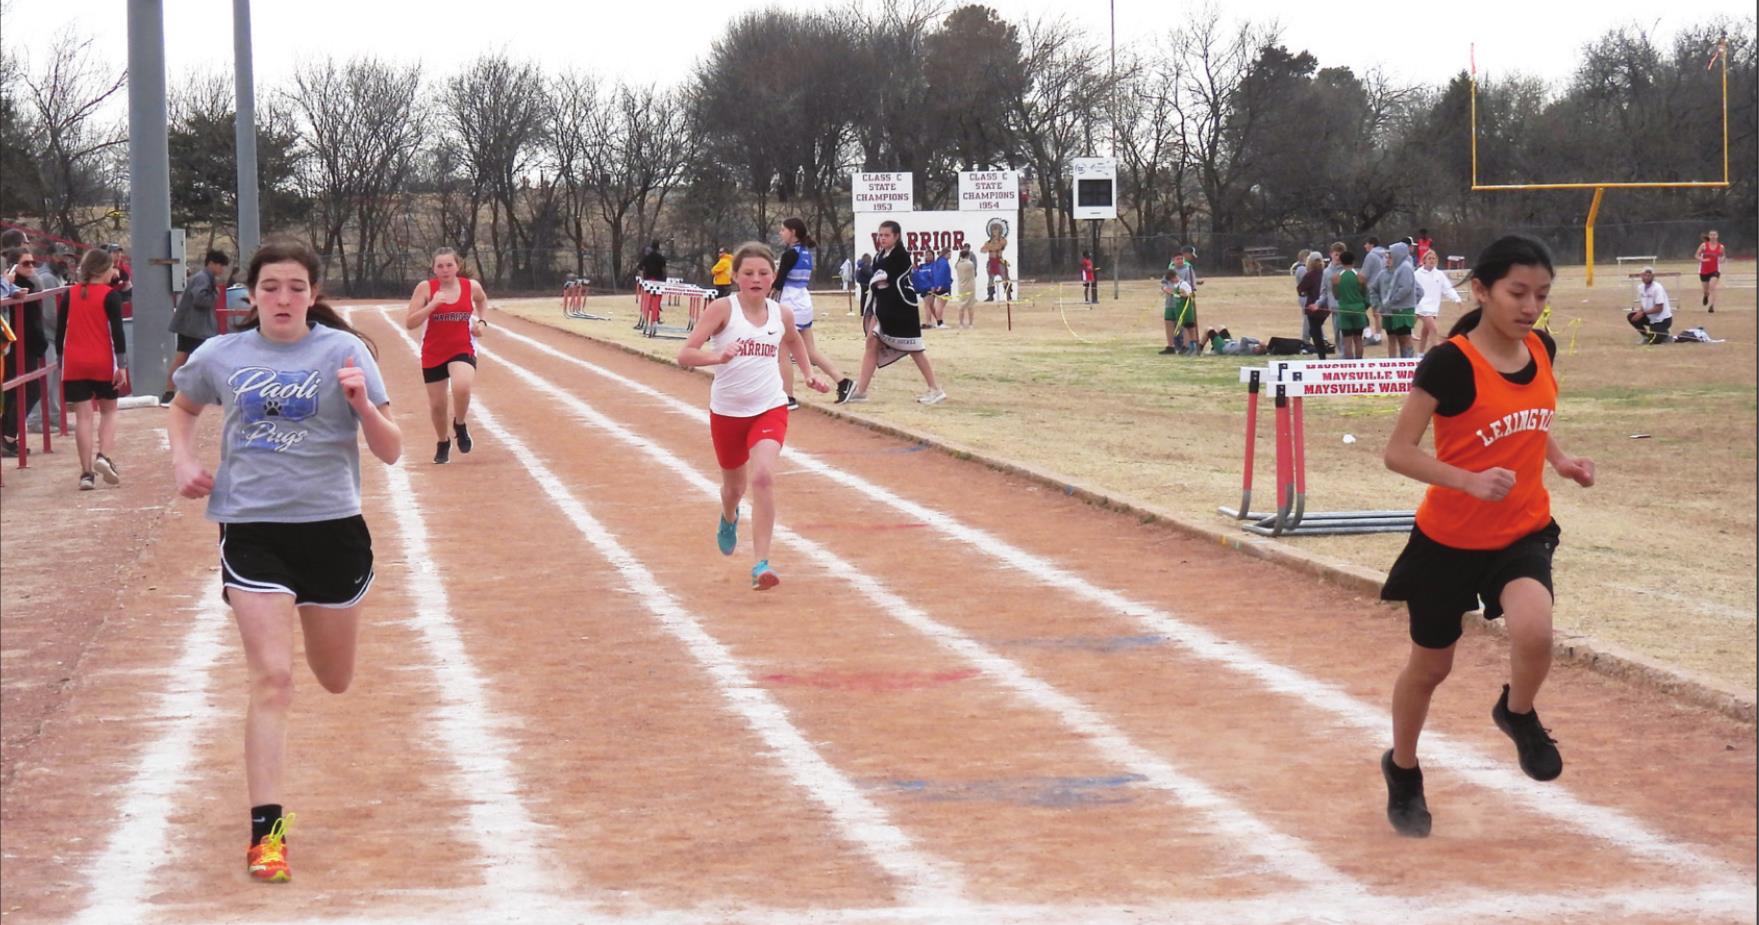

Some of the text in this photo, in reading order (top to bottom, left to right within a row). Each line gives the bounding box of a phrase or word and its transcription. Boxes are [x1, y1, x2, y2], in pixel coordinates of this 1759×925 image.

[969, 172, 1008, 181] CLASS C
[868, 183, 897, 191] STATE
[975, 182, 1003, 190] STATE
[856, 193, 909, 201] CHAMPIONS
[962, 191, 1015, 200] CHAMPIONS
[873, 203, 893, 211] 1953
[979, 201, 1000, 209] 1954
[871, 231, 965, 251] WRRIOR
[1322, 371, 1392, 381] MAYSVILLE
[228, 366, 321, 402] Paoli
[1304, 383, 1375, 394] MAYSVILLE
[243, 420, 309, 452] Pugs
